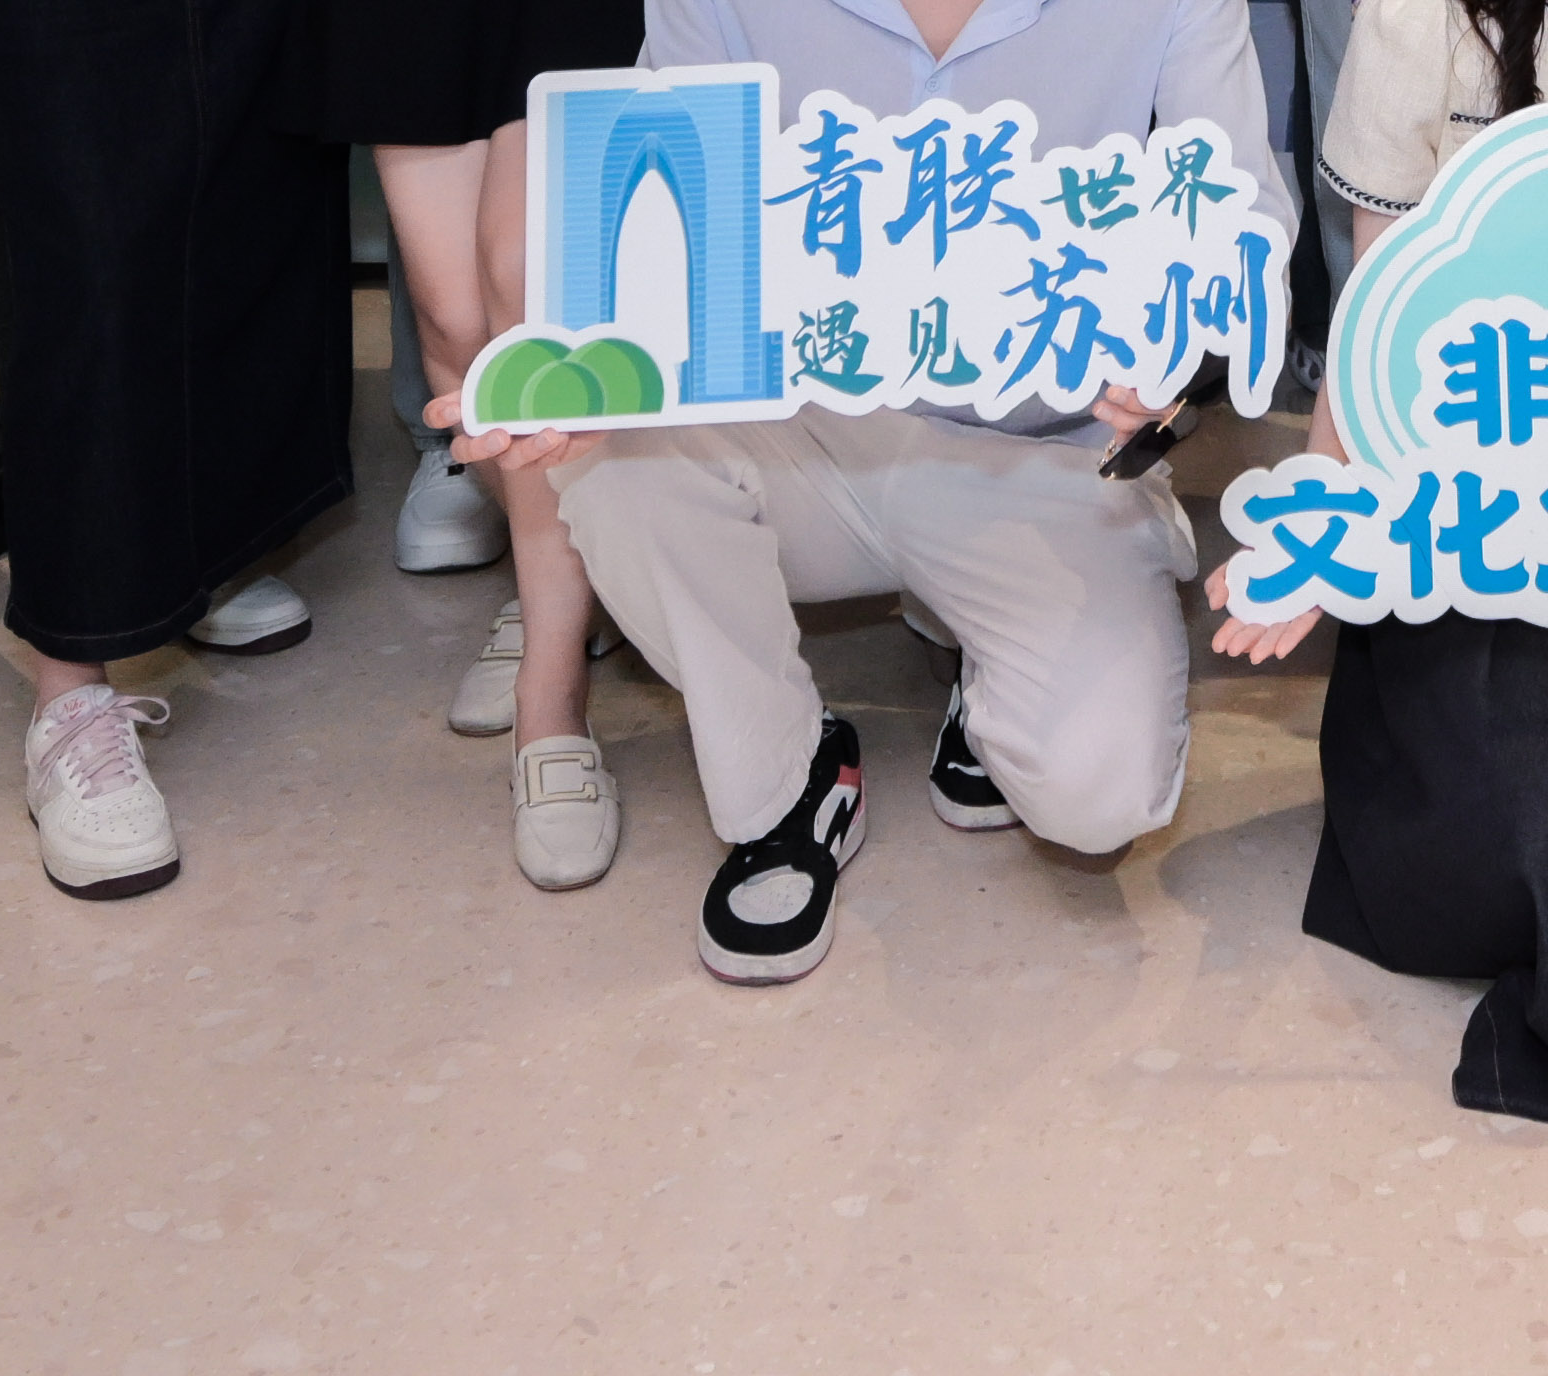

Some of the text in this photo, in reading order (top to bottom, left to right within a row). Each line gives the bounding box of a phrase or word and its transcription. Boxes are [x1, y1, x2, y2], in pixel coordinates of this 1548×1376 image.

[763, 109, 1237, 279] 青联世界
[790, 231, 1271, 398] 遇见苏州
